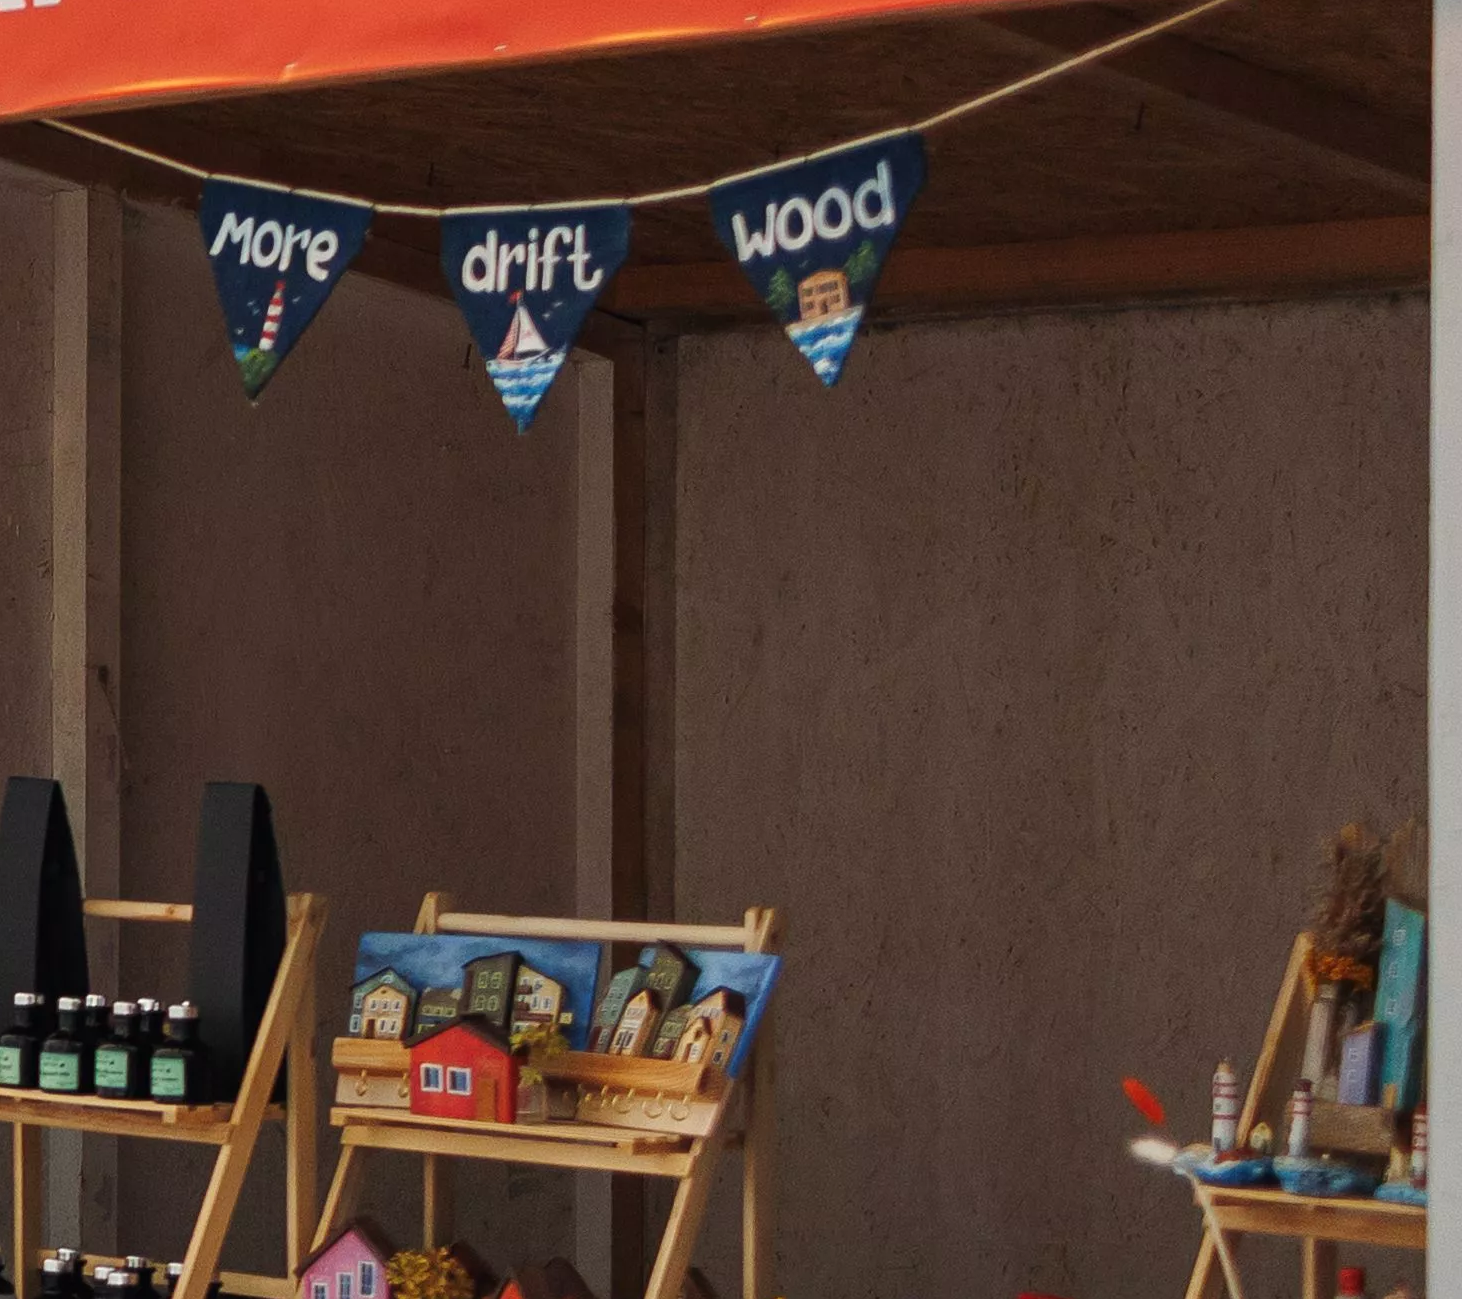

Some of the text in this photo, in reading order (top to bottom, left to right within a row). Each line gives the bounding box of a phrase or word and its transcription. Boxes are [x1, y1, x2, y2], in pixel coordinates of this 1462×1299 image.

[210, 160, 896, 293] More drift wood
